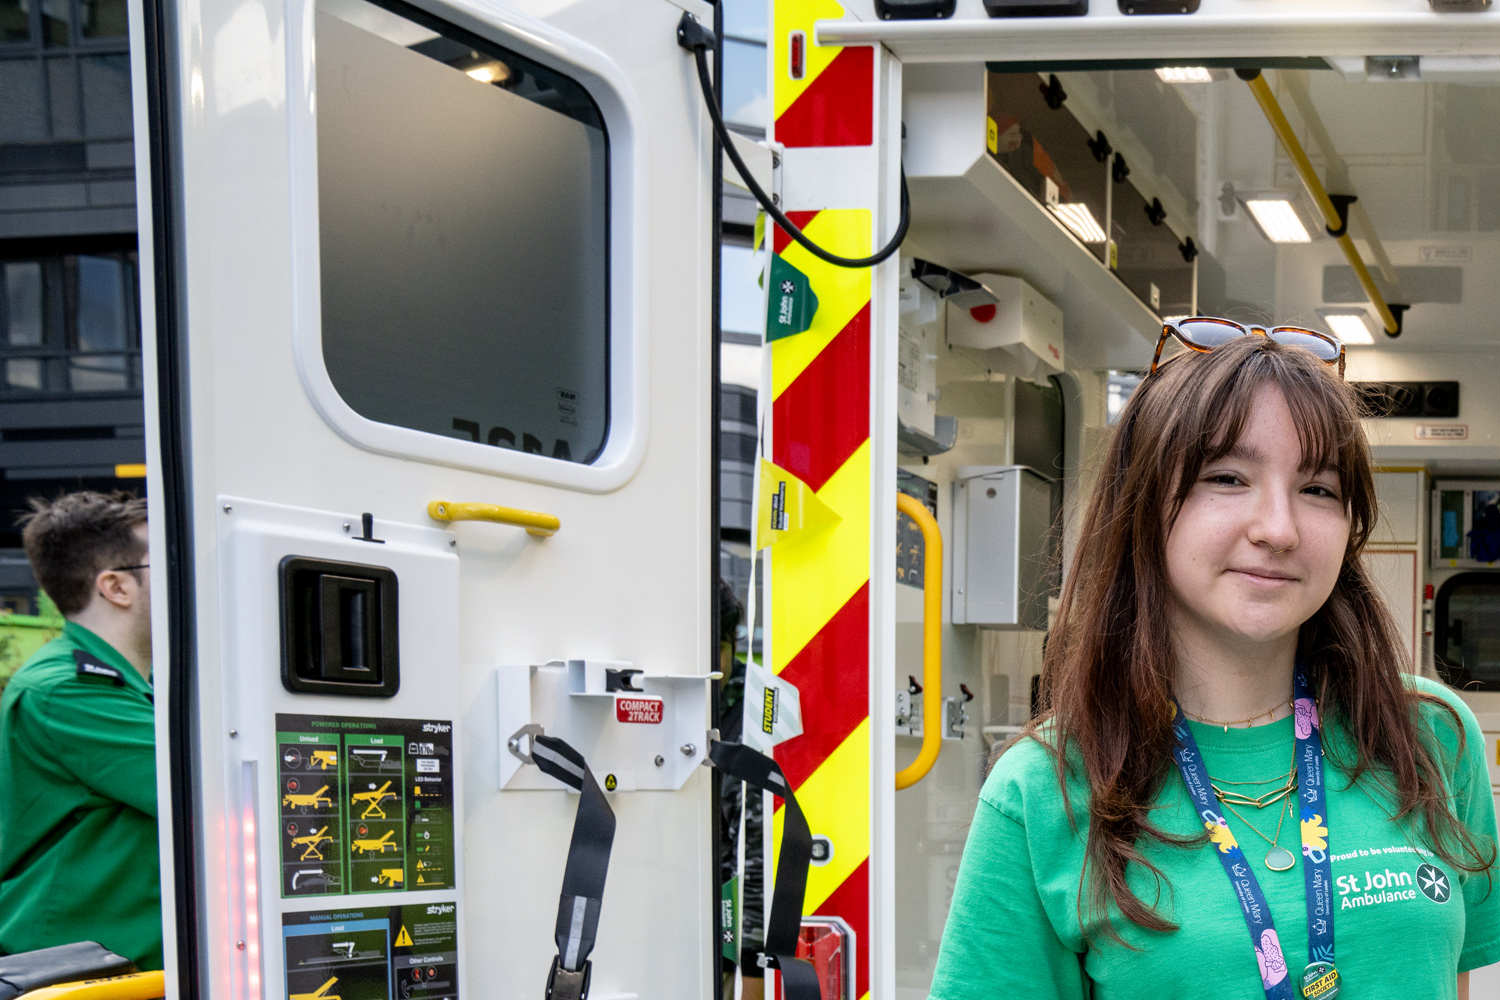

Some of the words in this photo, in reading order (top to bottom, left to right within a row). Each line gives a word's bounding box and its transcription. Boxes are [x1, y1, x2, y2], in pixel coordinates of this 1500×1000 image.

[620, 700, 660, 712] COMPACT
[763, 688, 774, 734] STUDENT
[628, 711, 660, 722] 2TRACK
[341, 722, 376, 730] OPERATIONS
[422, 723, 450, 733] stryker
[1305, 744, 1314, 762] Mary
[1306, 762, 1315, 786] Queen
[1188, 764, 1201, 788] Queen
[1197, 787, 1209, 805] Mary
[1330, 850, 1358, 862] Proud
[1359, 848, 1369, 857] to
[1370, 847, 1382, 855] be
[1313, 869, 1323, 888] Mary
[1336, 874, 1361, 895] St
[1364, 869, 1412, 891] John
[1241, 879, 1255, 903] Queen
[1251, 904, 1262, 924] Mary
[1315, 890, 1324, 915] Queen
[1341, 889, 1416, 910] Ambulance
[333, 912, 364, 920] OPERATIONS
[426, 905, 454, 915] stryker
[1304, 980, 1323, 995] FIRST
[1324, 972, 1336, 984] AID
[1313, 982, 1333, 996] SOCIETY
